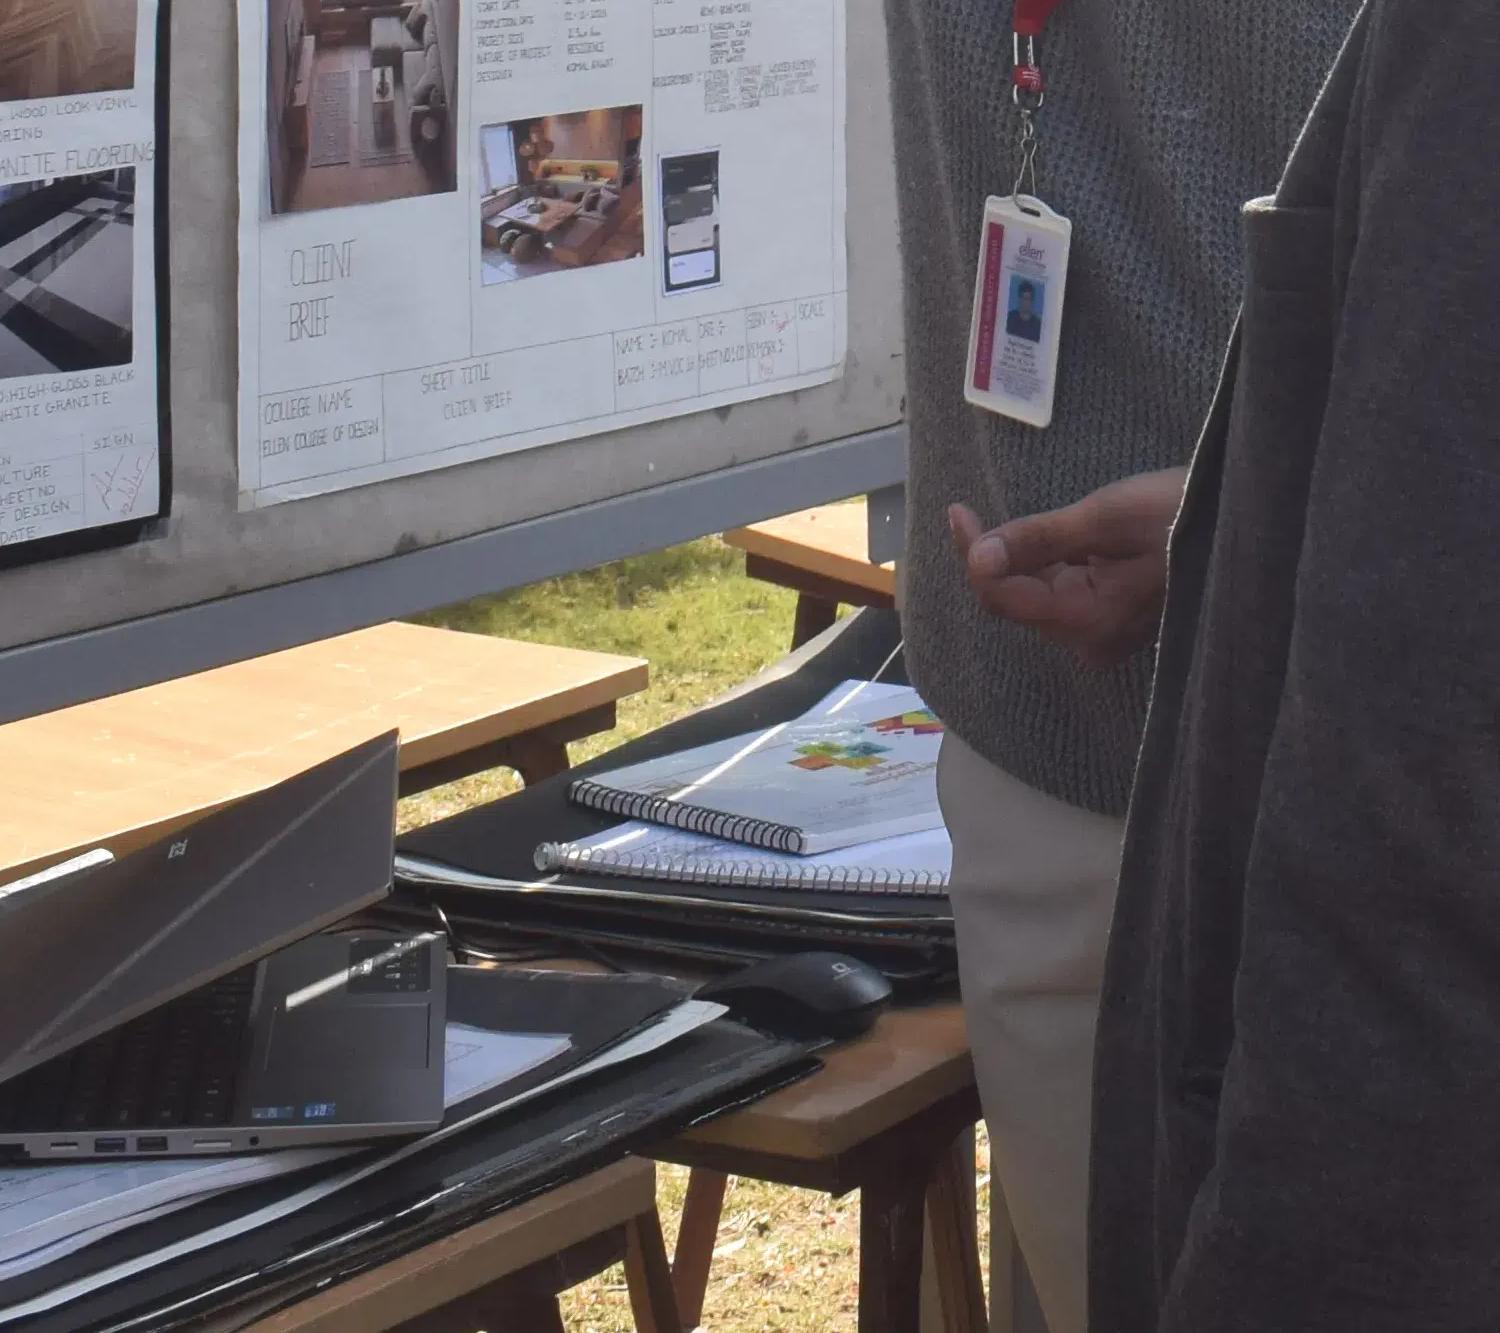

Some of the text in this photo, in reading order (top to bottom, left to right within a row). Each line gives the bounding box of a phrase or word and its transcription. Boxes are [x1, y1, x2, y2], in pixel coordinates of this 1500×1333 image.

[66, 142, 155, 170] FLOORING
[1019, 237, 1044, 260] ellen
[290, 239, 356, 286] CLIENT
[290, 296, 334, 341] BRIEF
[95, 369, 135, 390] BLACK
[46, 391, 111, 414] GRANITE
[265, 388, 353, 424] COLLEGE NAME
[92, 433, 134, 451] SIGN
[14, 500, 70, 521] DESIGN
